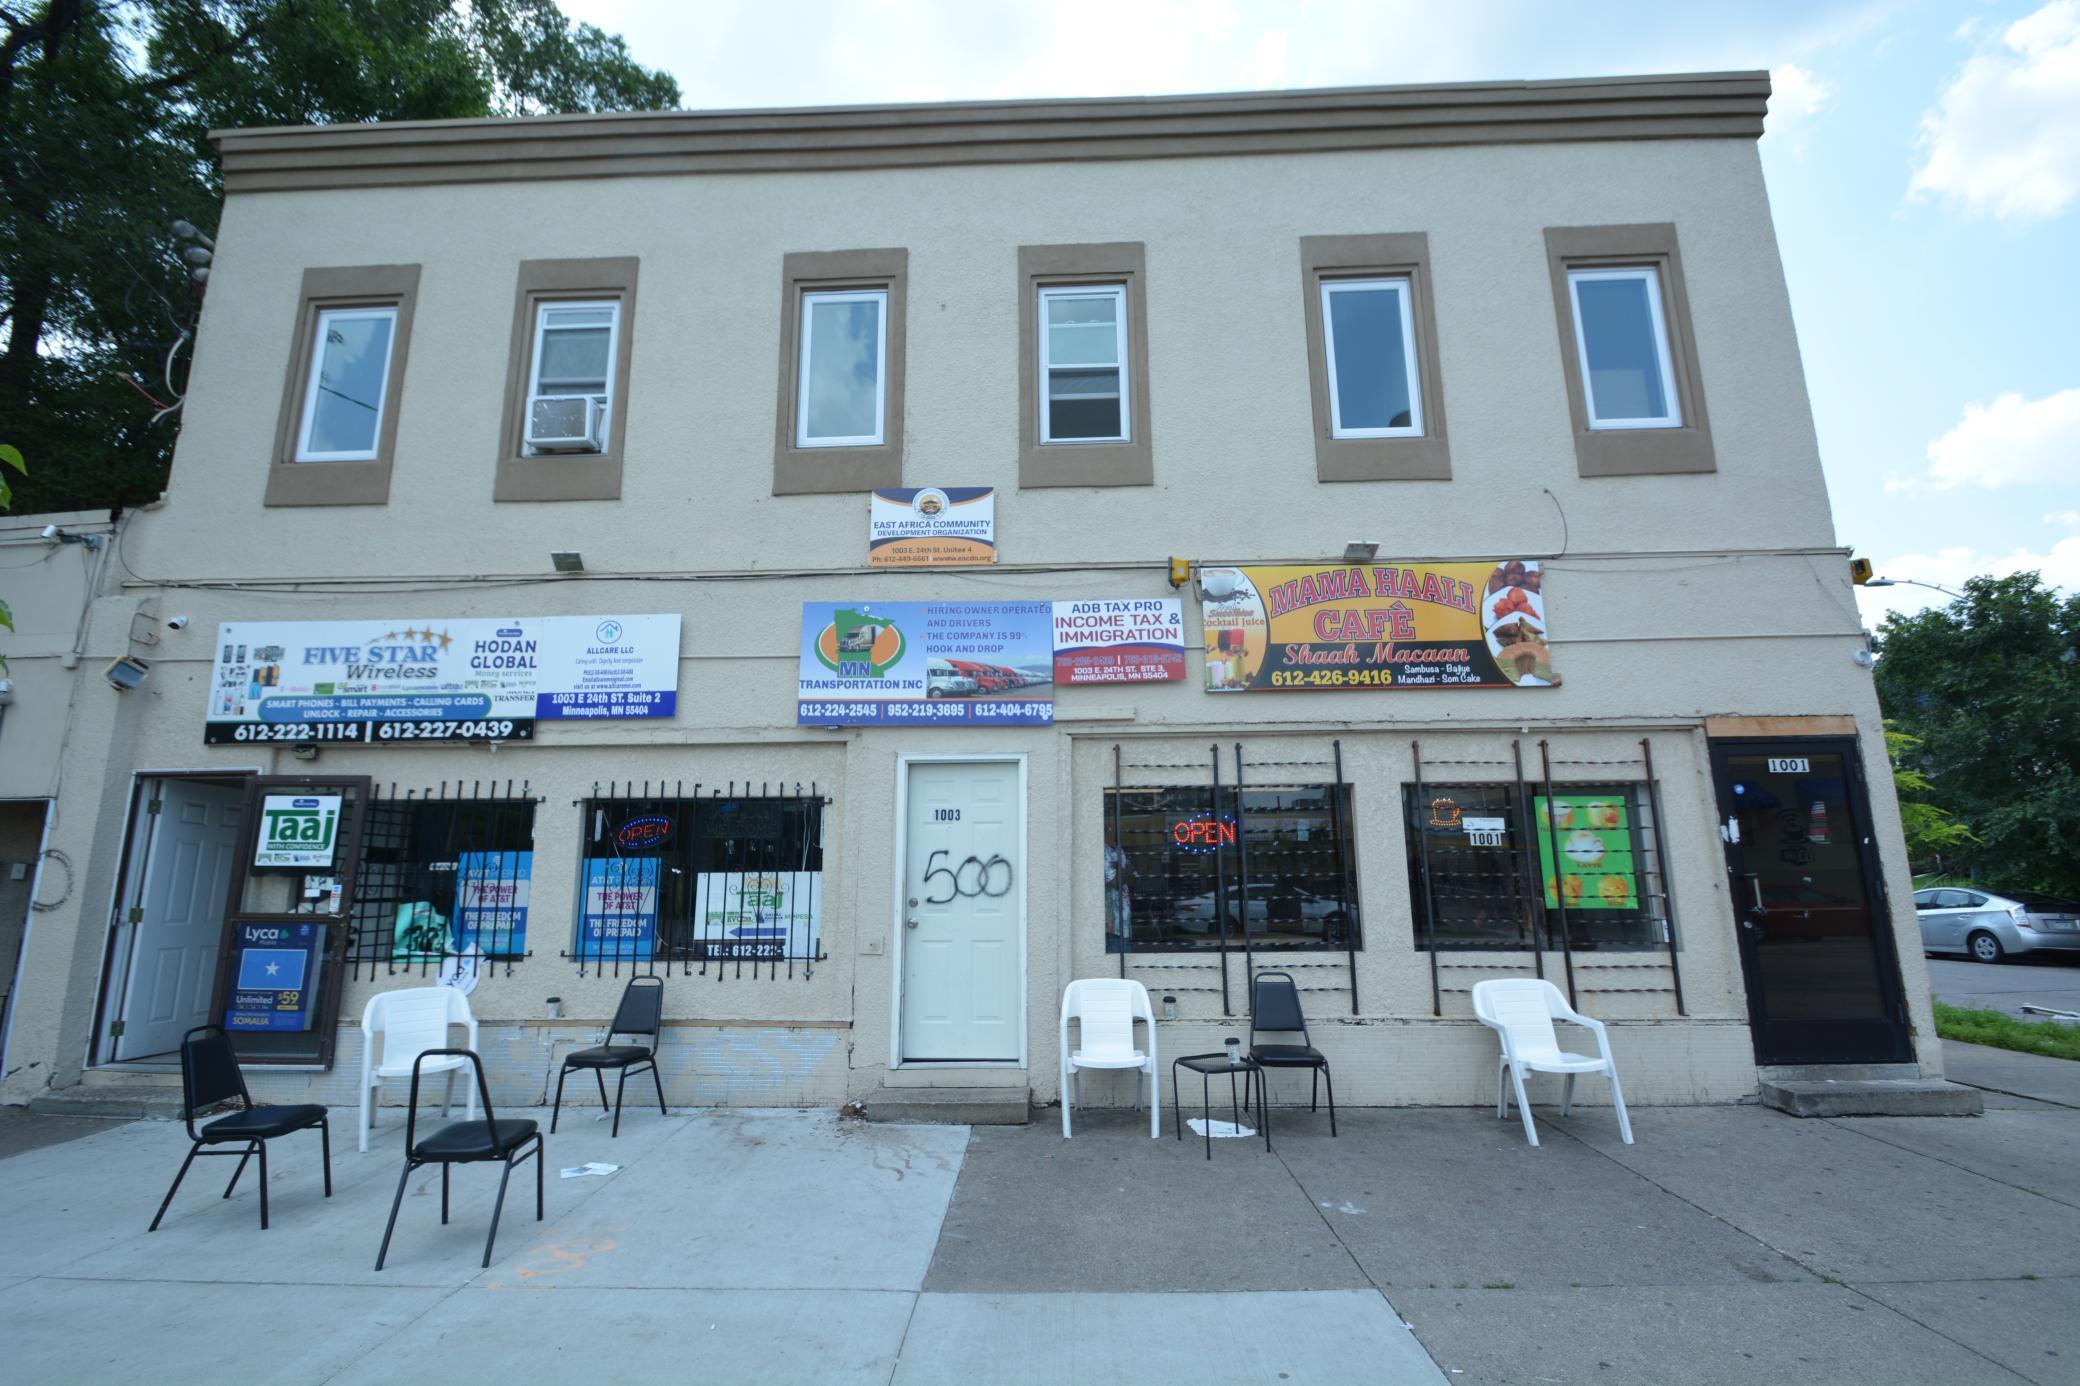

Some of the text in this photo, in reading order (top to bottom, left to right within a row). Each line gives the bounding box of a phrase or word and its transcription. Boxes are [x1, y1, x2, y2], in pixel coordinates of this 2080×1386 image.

[874, 520, 991, 529] EAST AFRICA COMMUNITY
[1269, 567, 1476, 619] MAMA HAALI
[927, 606, 1051, 614] HIRING OWNER OPERATED
[1072, 601, 1163, 614] ADB TAX PRO
[927, 619, 991, 627] AND DRIVERS
[1055, 612, 1181, 628] INCOME TAX &
[927, 632, 944, 640] THE
[946, 632, 995, 640] COMPANY
[997, 632, 1007, 640] IS
[1059, 627, 1178, 643] IMMIGRATION
[474, 640, 537, 653] HODAN
[926, 644, 1004, 653] HOOK AND DROP
[303, 645, 438, 665] FIVE STAR
[1283, 642, 1470, 665] Shaah Macaan
[470, 656, 537, 669] GLOBAL
[1404, 664, 1439, 673] Sambusa
[347, 664, 438, 680] Wireless
[475, 670, 499, 678] Money
[839, 661, 871, 677] MN
[1072, 671, 1168, 681] MINNEAPOLIS, MN 55404
[1271, 669, 1392, 687] 612-426-9416
[1398, 675, 1436, 684] Mandhazi
[1441, 674, 1459, 683] Som
[1460, 673, 1481, 682] Cake
[799, 679, 923, 689] TRANSPORTATION INC
[267, 699, 296, 708] SMART
[298, 699, 334, 708] PHONES
[341, 698, 358, 707] BILL
[360, 698, 407, 706] PAYMENTS
[413, 697, 452, 706] CALLING
[454, 697, 484, 706] CARDS
[552, 692, 661, 703] 1003 E 24th ST. Suite 2
[304, 710, 340, 718] UNLOCK
[347, 709, 378, 718] REPAIR
[384, 708, 443, 717] ACCESSORIES
[562, 705, 648, 717] Minneapolis, MN 55404
[800, 704, 1053, 717] 612-224-2545 952-219-3695 612-404-6795
[234, 721, 513, 741] 612-222-1114 612-227-0439
[1771, 760, 1807, 771] 1001
[934, 809, 961, 821] 1003
[265, 810, 335, 850] Taaj
[618, 821, 670, 842] OPEN
[1174, 822, 1235, 844] OPEN
[1472, 833, 1500, 845] 1001
[245, 926, 279, 941] Lyca
[236, 995, 274, 1003] Unlimited
[232, 1017, 269, 1025] SOMALIA
